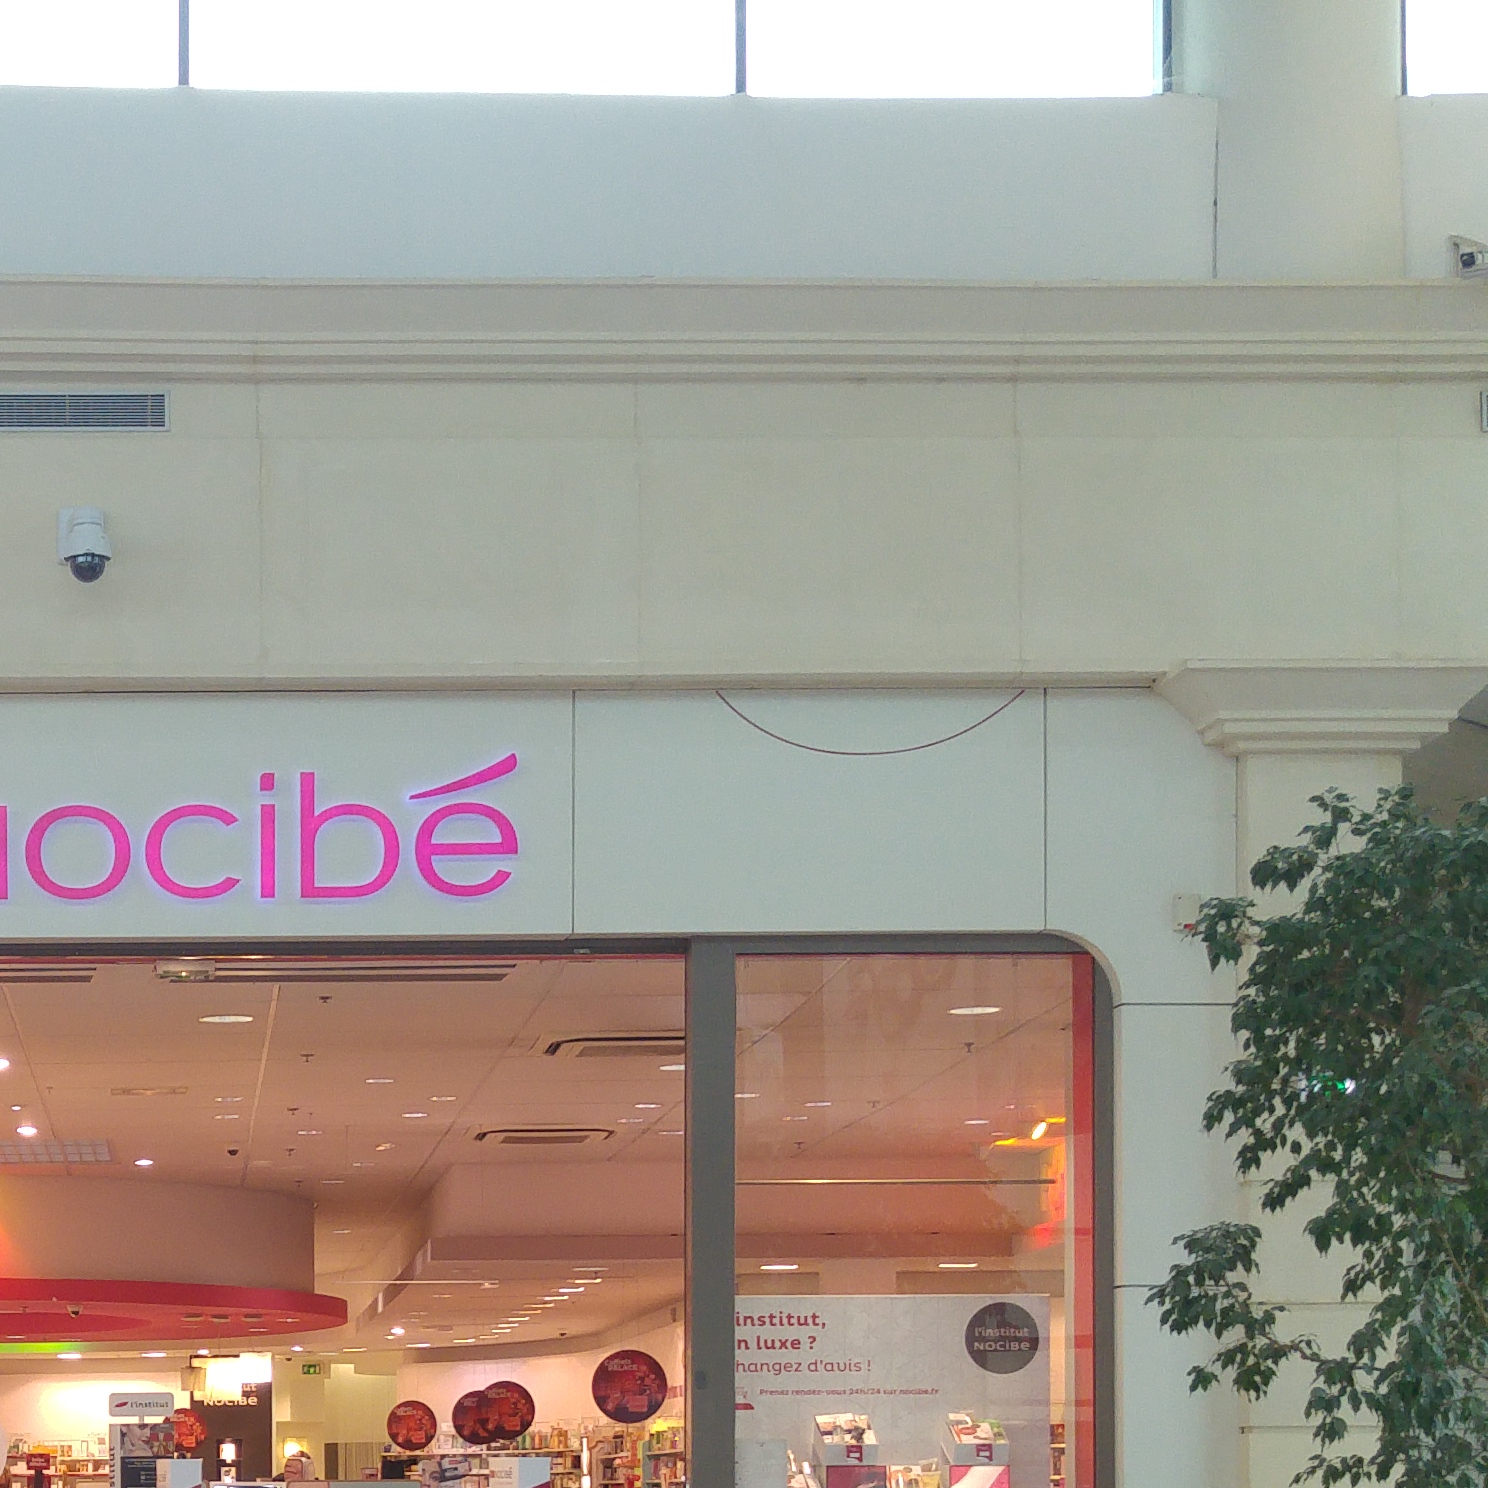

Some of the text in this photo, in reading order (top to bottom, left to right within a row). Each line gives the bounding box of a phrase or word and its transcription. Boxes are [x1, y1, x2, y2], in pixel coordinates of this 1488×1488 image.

[974, 1326, 1030, 1337] l'institut
[756, 1335, 801, 1350] luxe
[807, 1335, 817, 1350] ?
[866, 1360, 872, 1372] !
[760, 1388, 789, 1396] Prenez
[849, 1388, 881, 1396] 24h/24
[883, 1388, 898, 1396] sur
[130, 1401, 169, 1409] l'institut
